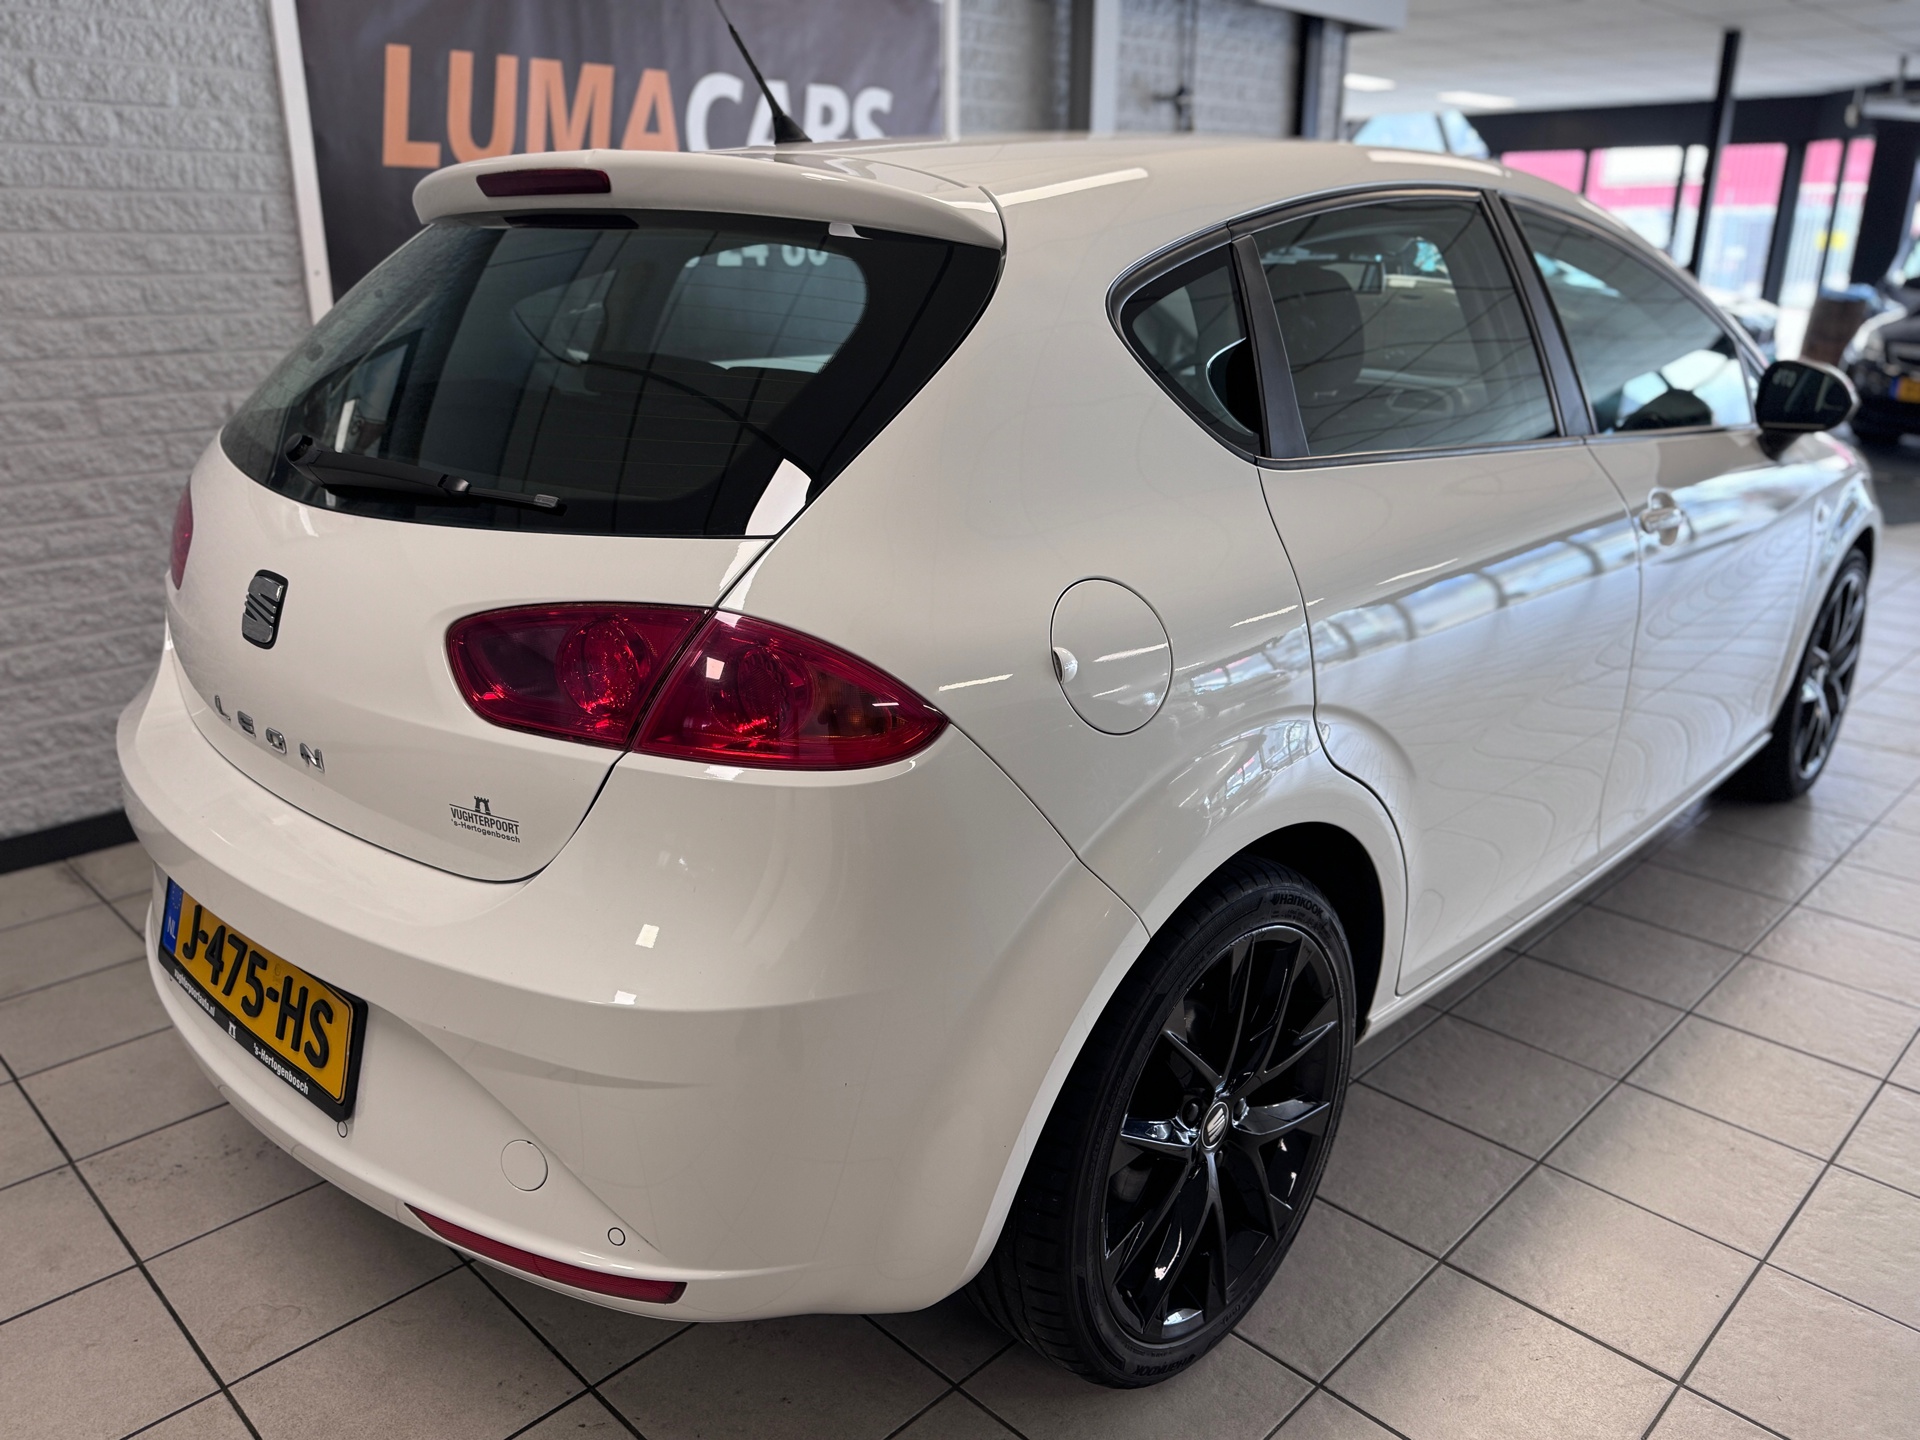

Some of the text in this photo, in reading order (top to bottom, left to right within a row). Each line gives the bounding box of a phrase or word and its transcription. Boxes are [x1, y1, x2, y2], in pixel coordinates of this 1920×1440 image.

[214, 695, 325, 773] LEON
[450, 807, 519, 835] VUGHTERPOORT
[167, 916, 176, 940] NL
[174, 968, 215, 1017] vughterpoortauto.nl
[182, 904, 334, 1069] J-475-HS
